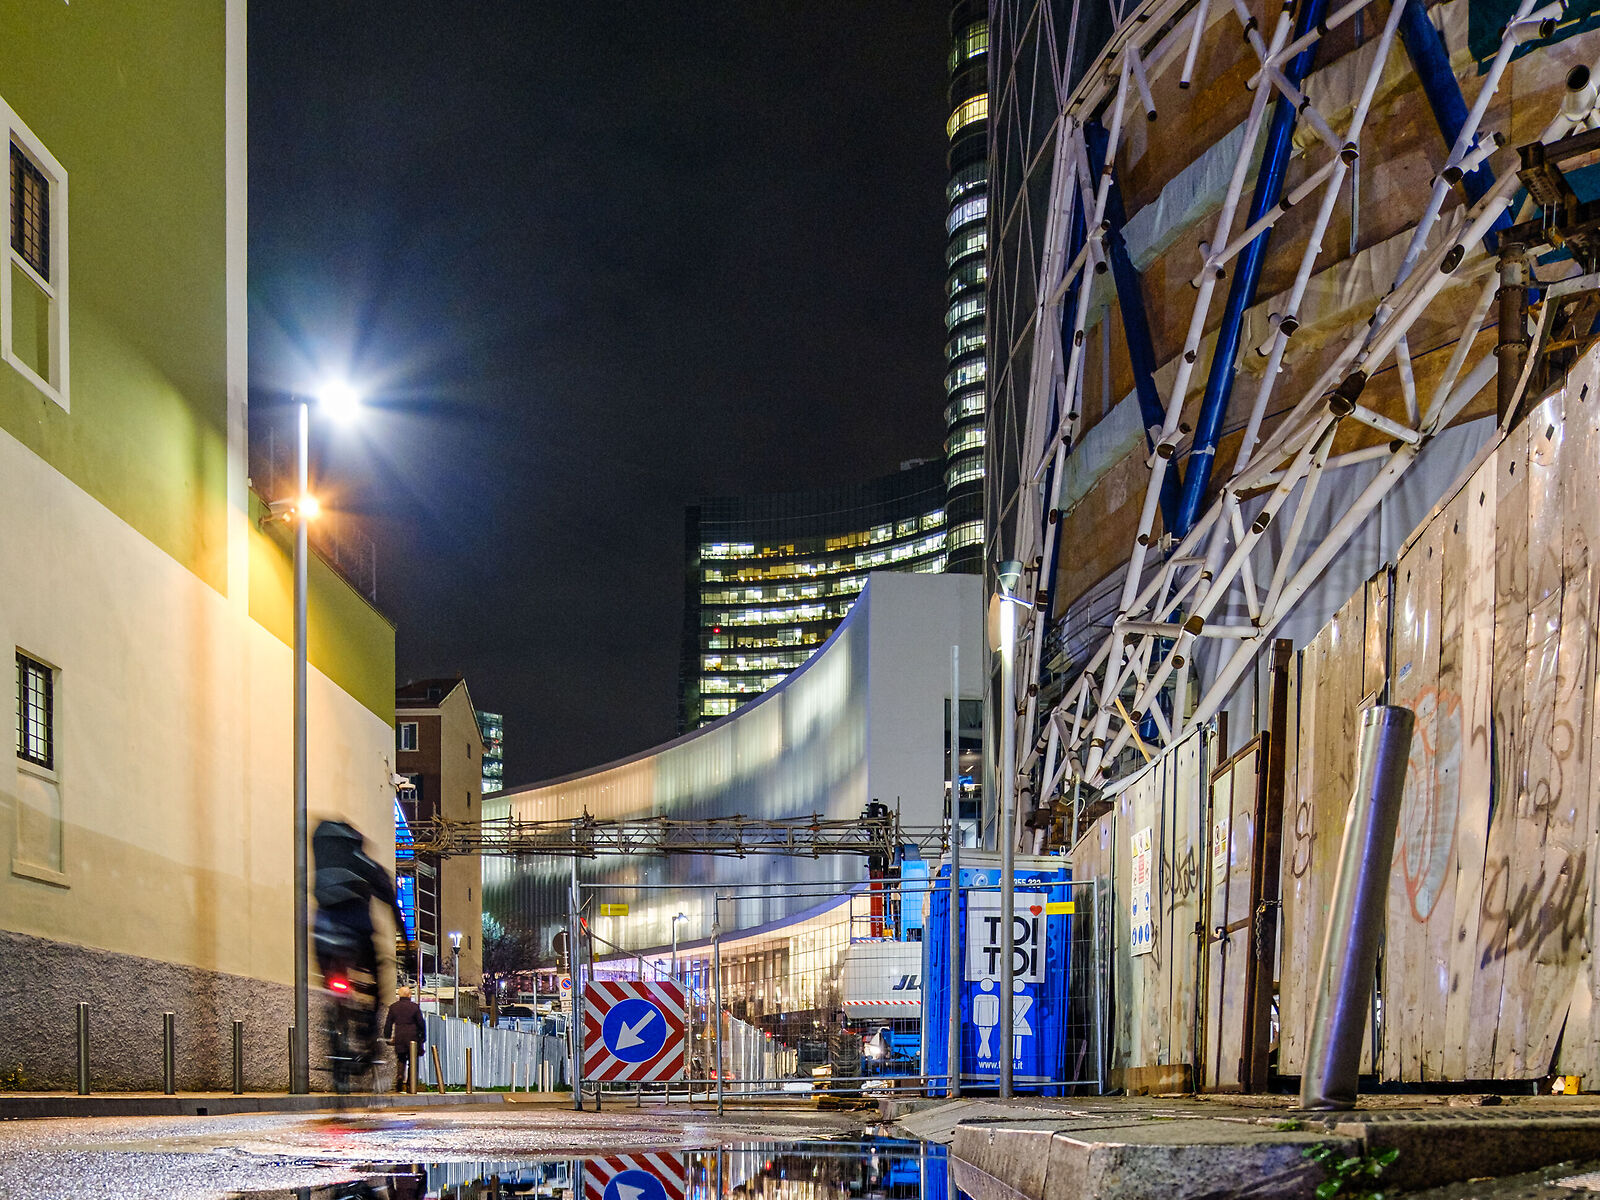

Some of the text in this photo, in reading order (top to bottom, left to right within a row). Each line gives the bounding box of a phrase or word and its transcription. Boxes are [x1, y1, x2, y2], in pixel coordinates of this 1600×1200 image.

[984, 916, 1039, 946] TOI
[983, 946, 1037, 977] TOI
[892, 974, 922, 991] JL
